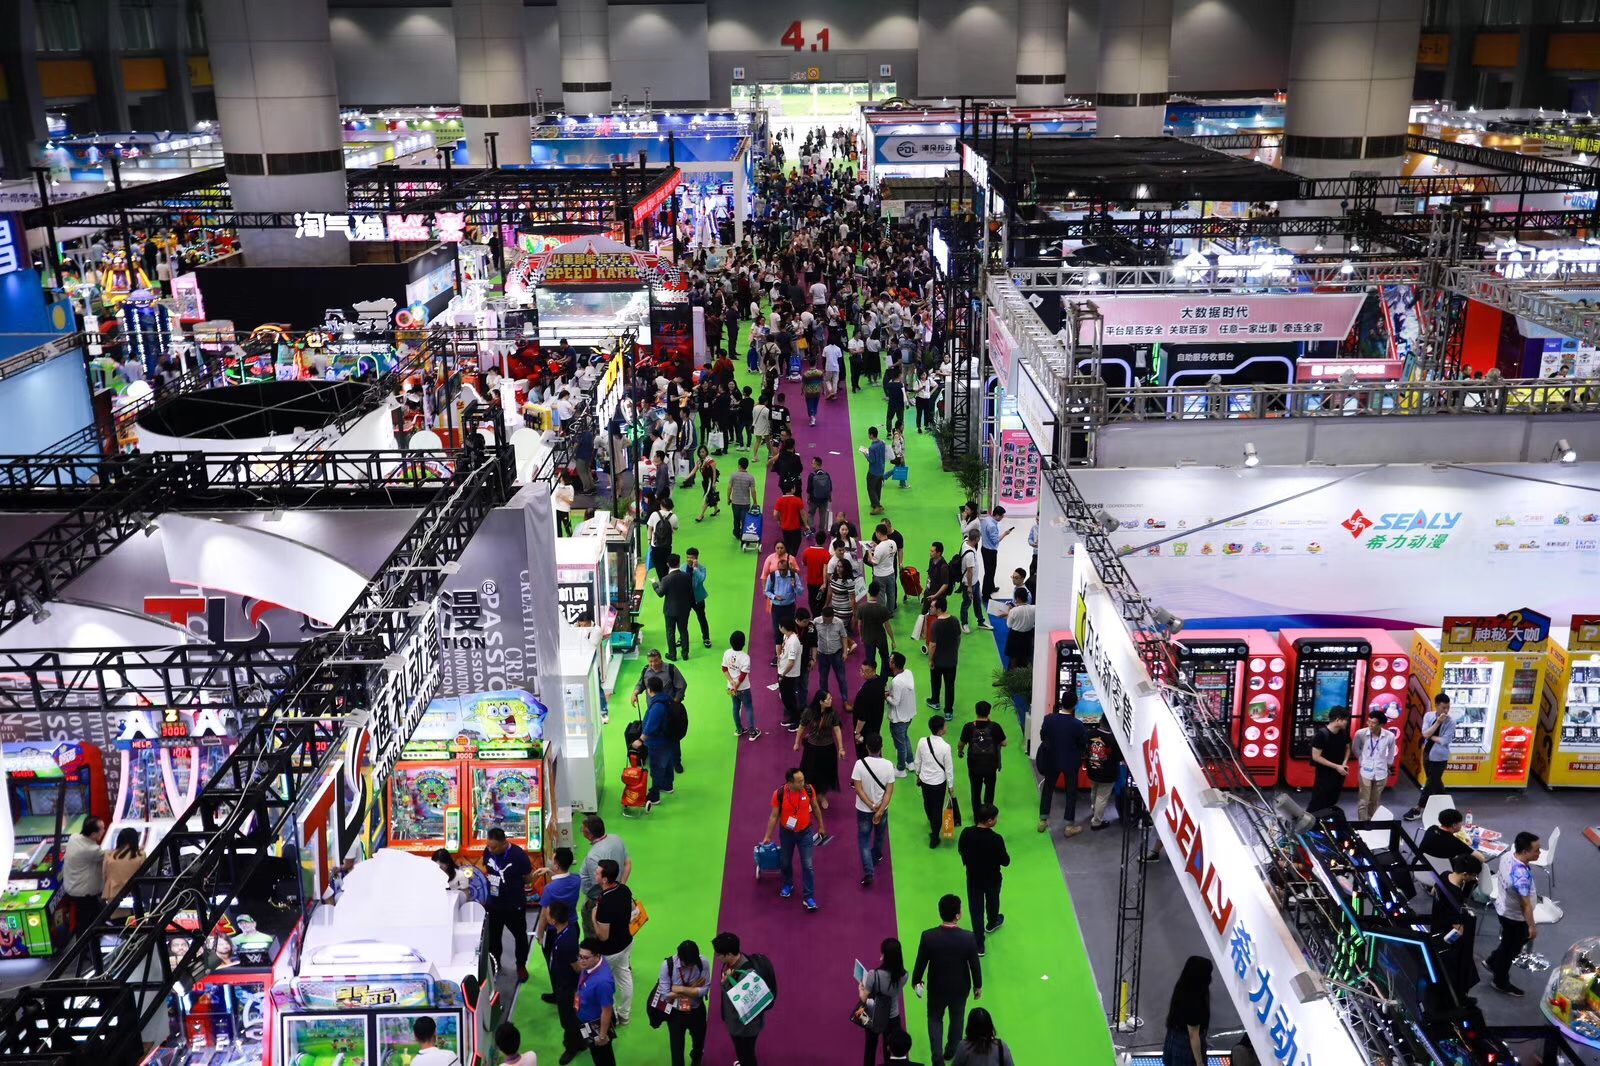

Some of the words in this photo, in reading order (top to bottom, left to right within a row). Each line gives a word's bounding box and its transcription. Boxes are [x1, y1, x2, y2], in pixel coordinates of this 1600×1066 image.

[781, 20, 829, 52] 4.1
[294, 211, 385, 240] 淘气猫
[546, 267, 592, 279] SPEED
[597, 266, 638, 279] KART
[1181, 306, 1249, 319] 大数据时代
[1105, 325, 1163, 336] 平台是否安全
[1169, 325, 1208, 335] 关联百家
[1219, 324, 1277, 334] 任意一家出事
[1283, 323, 1322, 333] 牵连全家
[1176, 353, 1234, 362] 自助服务收银台
[1373, 508, 1463, 532] SEALY
[1366, 534, 1449, 550] 希力动漫
[1474, 628, 1540, 642] 神秘大咖
[373, 611, 439, 757] 通利动漫
[377, 742, 398, 784] TONG
[408, 666, 443, 734] ANIMATION
[1165, 786, 1233, 935] SEALY
[1230, 920, 1313, 1066] 希力动
